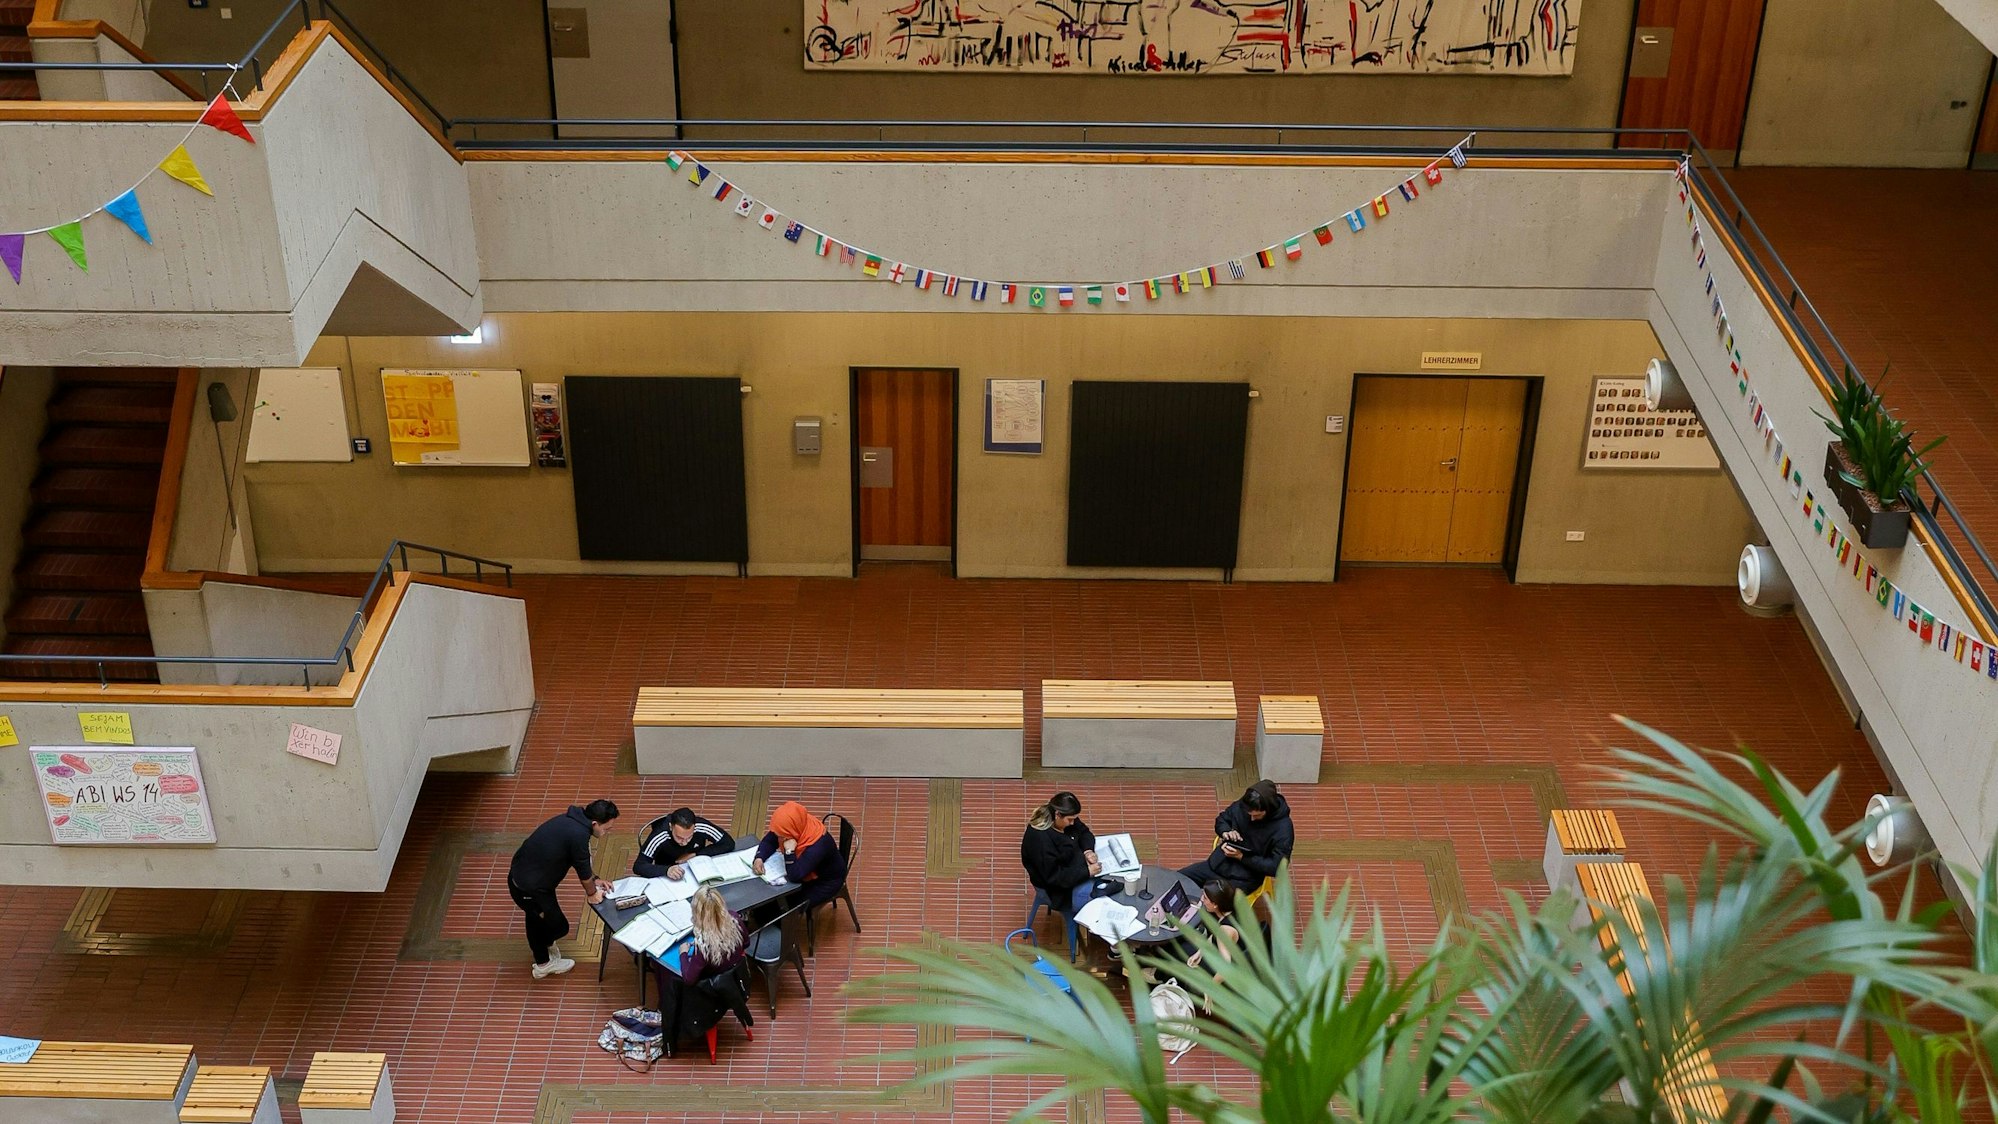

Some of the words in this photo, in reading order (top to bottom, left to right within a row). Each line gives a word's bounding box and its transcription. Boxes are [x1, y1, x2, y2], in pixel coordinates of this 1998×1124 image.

[1423, 356, 1479, 365] LEHRERZIMMER
[387, 401, 435, 419] DEN
[83, 725, 103, 733] BEM
[76, 784, 106, 804] ABI
[112, 785, 136, 803] WS
